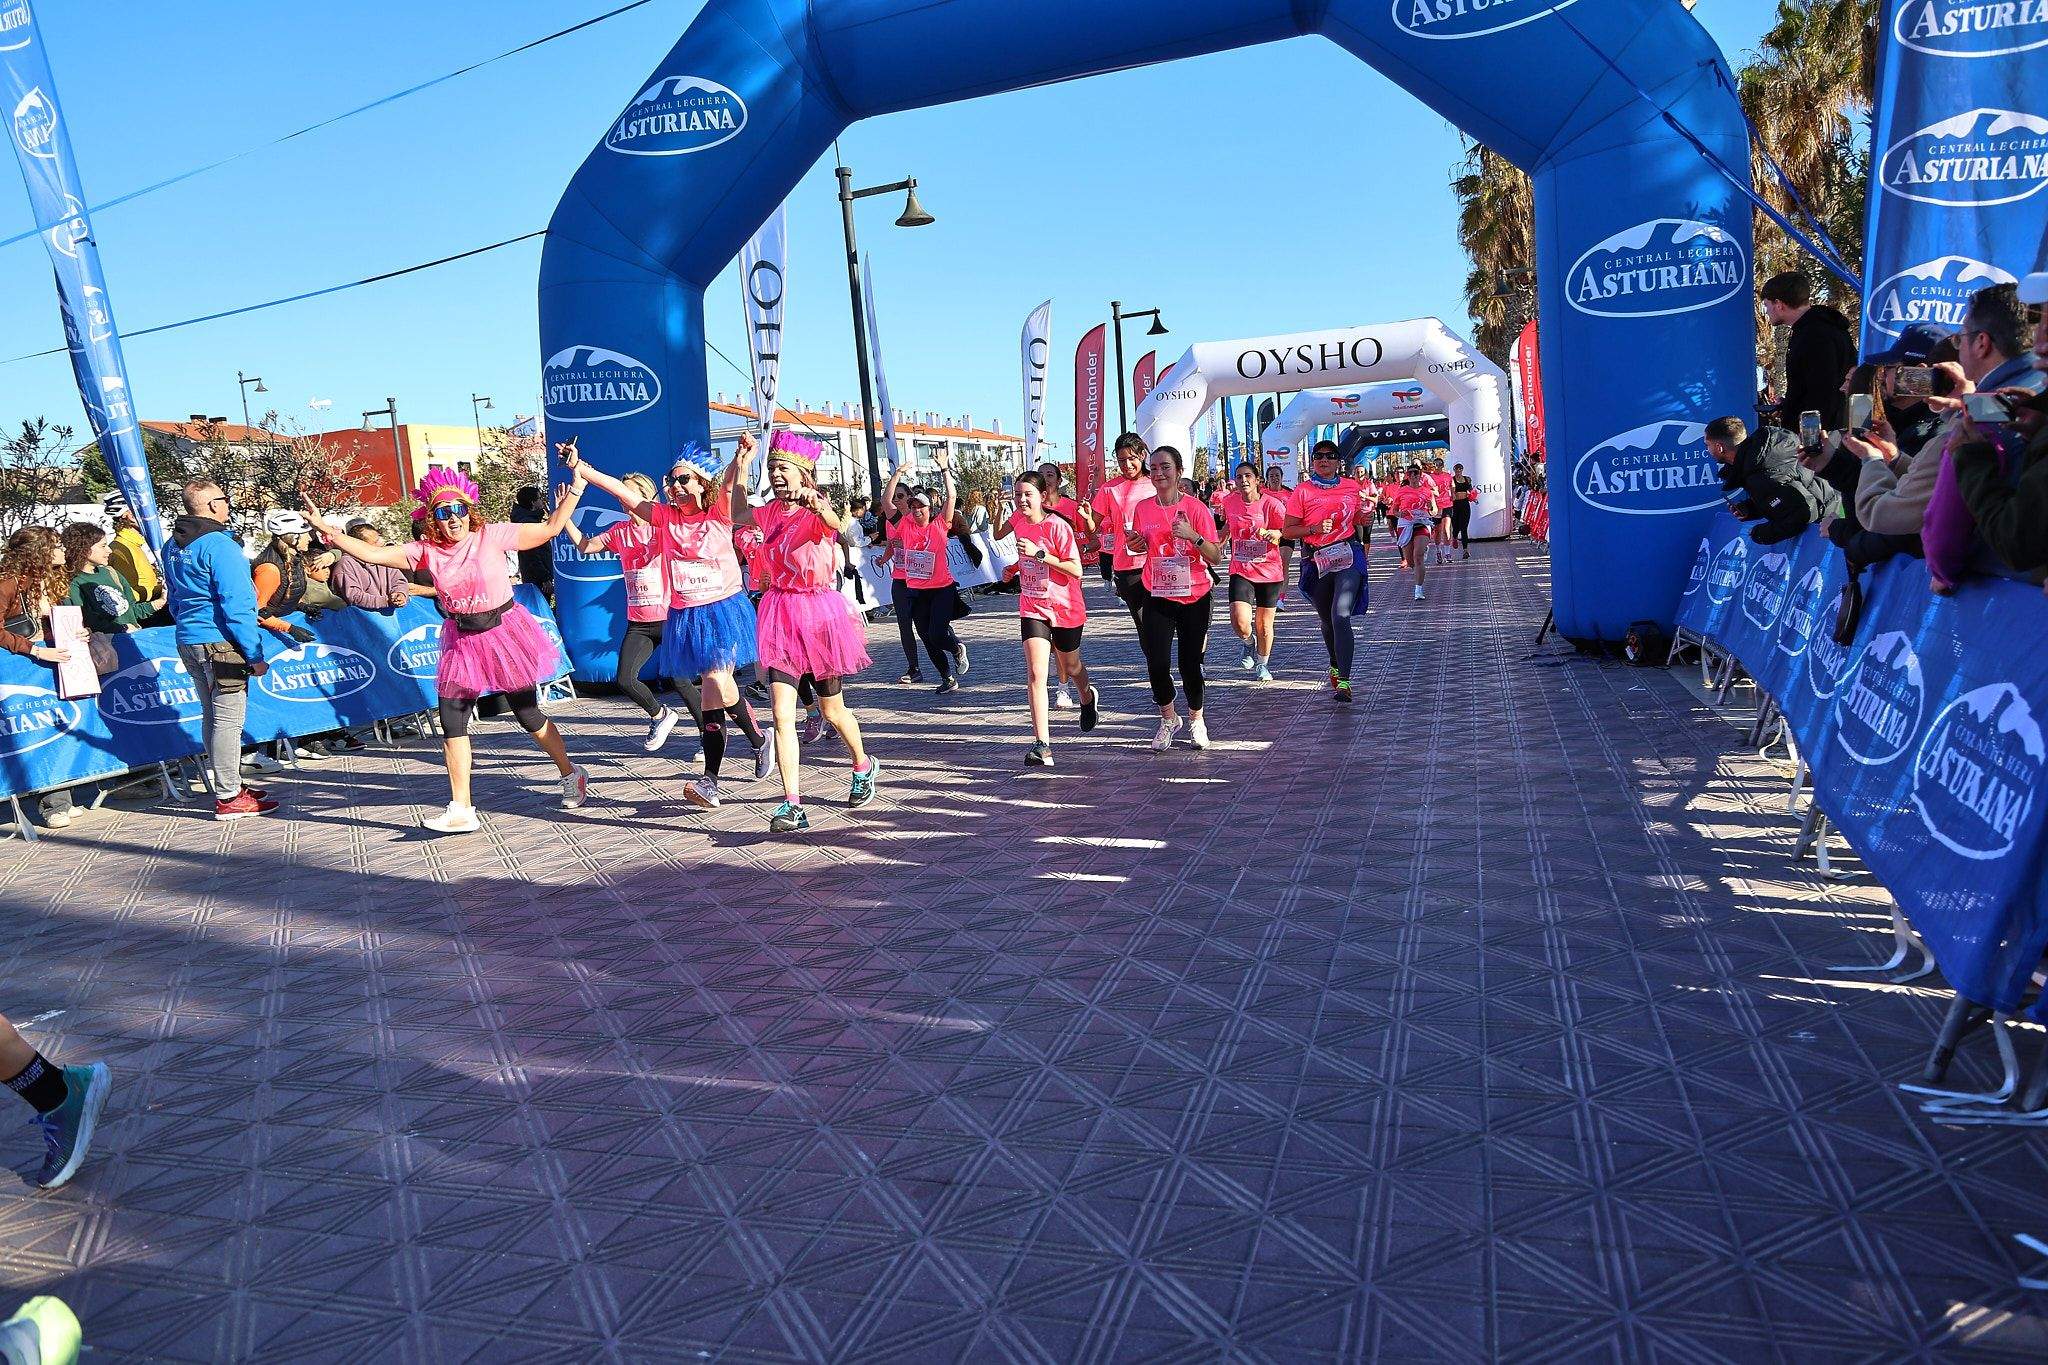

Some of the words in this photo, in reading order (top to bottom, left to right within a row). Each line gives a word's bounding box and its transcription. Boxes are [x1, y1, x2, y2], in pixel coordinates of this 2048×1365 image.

[632, 101, 673, 118] CENTRAL
[677, 96, 728, 108] LECHERA
[610, 108, 737, 145] ASTURIANA
[1929, 143, 1986, 155] CENTRAL
[1605, 251, 1672, 270] CENTRAL
[1678, 247, 1734, 259] LECHERA
[1577, 261, 1739, 303] ASTURIANA
[1237, 337, 1383, 379] OYSHO
[1428, 359, 1475, 375] OYSHO
[550, 371, 588, 382] CENTRAL
[592, 370, 644, 379] LECHERA
[1525, 346, 1535, 411] Santander
[544, 378, 651, 406] ASTURIANA
[1086, 351, 1098, 430] Santander
[1155, 389, 1197, 402] OYSHO
[1370, 427, 1436, 438] VOLVO
[1612, 452, 1678, 467] CENTRAL
[1472, 482, 1503, 494] SHO
[1023, 574, 1037, 583] 016
[283, 663, 321, 673] CENTRAL
[324, 657, 360, 667] LECHERA
[129, 678, 177, 691] CENTRAL
[271, 664, 370, 693] ASTURIANA
